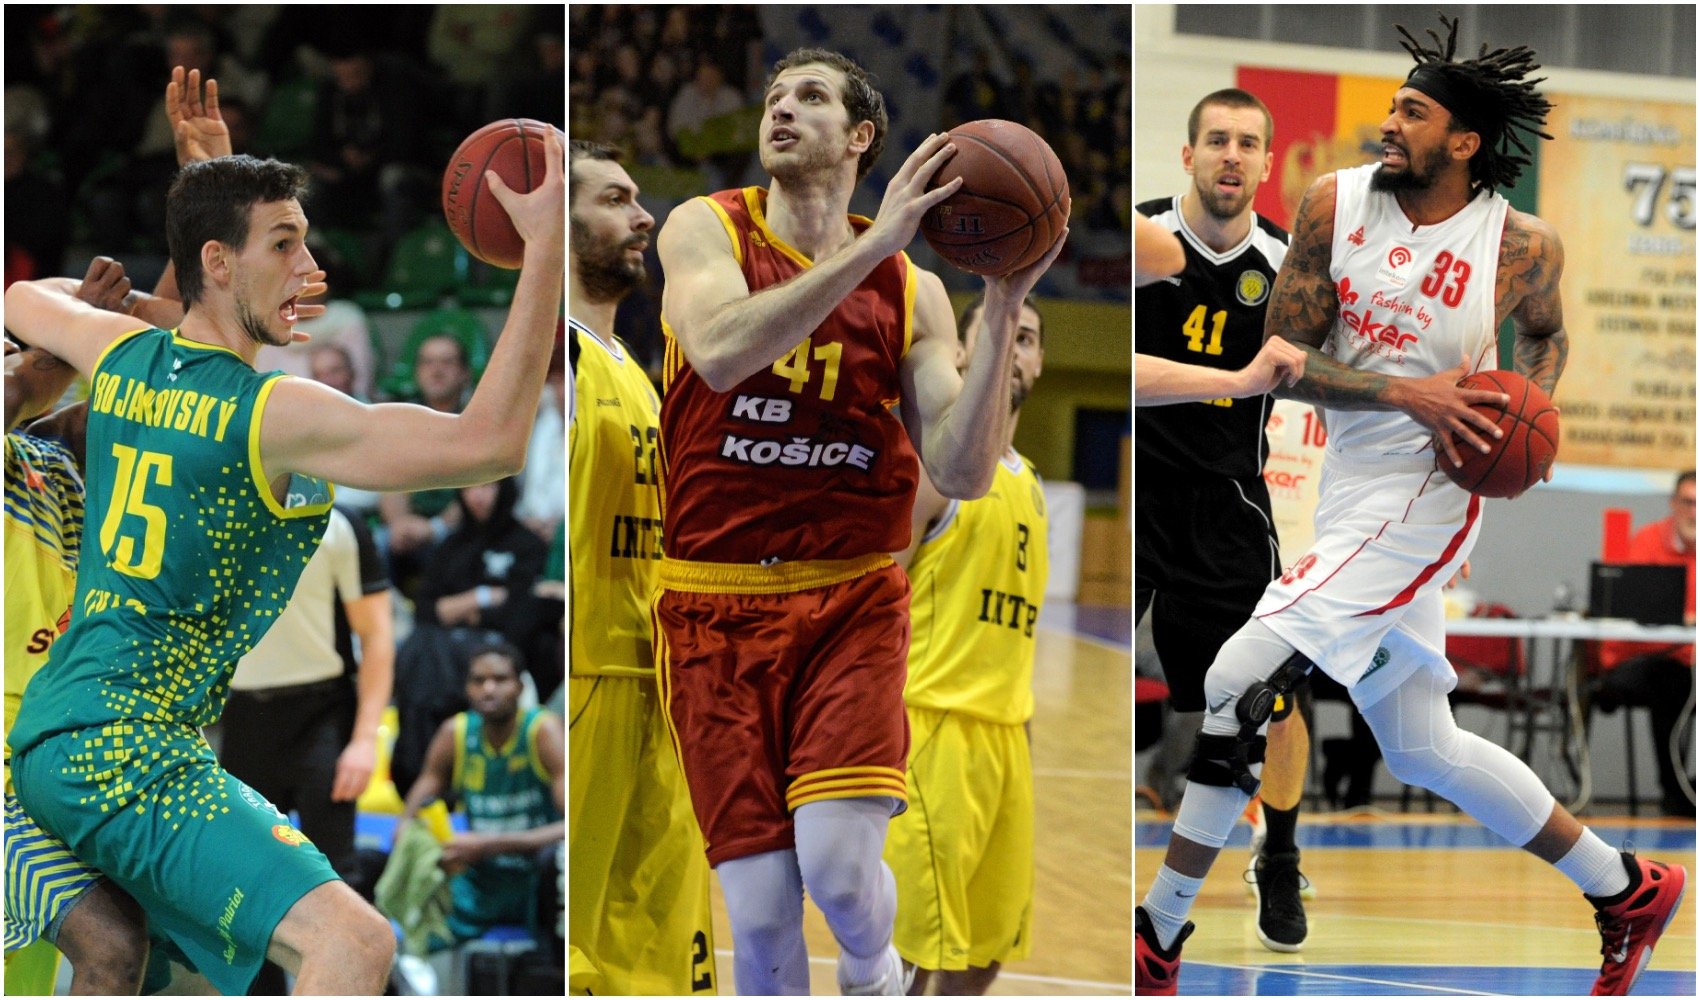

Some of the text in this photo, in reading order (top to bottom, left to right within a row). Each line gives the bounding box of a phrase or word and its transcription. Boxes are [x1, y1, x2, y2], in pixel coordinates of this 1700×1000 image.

[1421, 249, 1472, 310] 33
[1182, 304, 1228, 355] 41
[1337, 309, 1419, 350] eker
[1416, 305, 1432, 330] by
[771, 337, 843, 401] 41
[732, 395, 792, 423] KB
[1302, 410, 1328, 448] 10
[721, 435, 875, 470] KOŠICE
[99, 442, 173, 580] 15
[691, 930, 713, 993] 2
